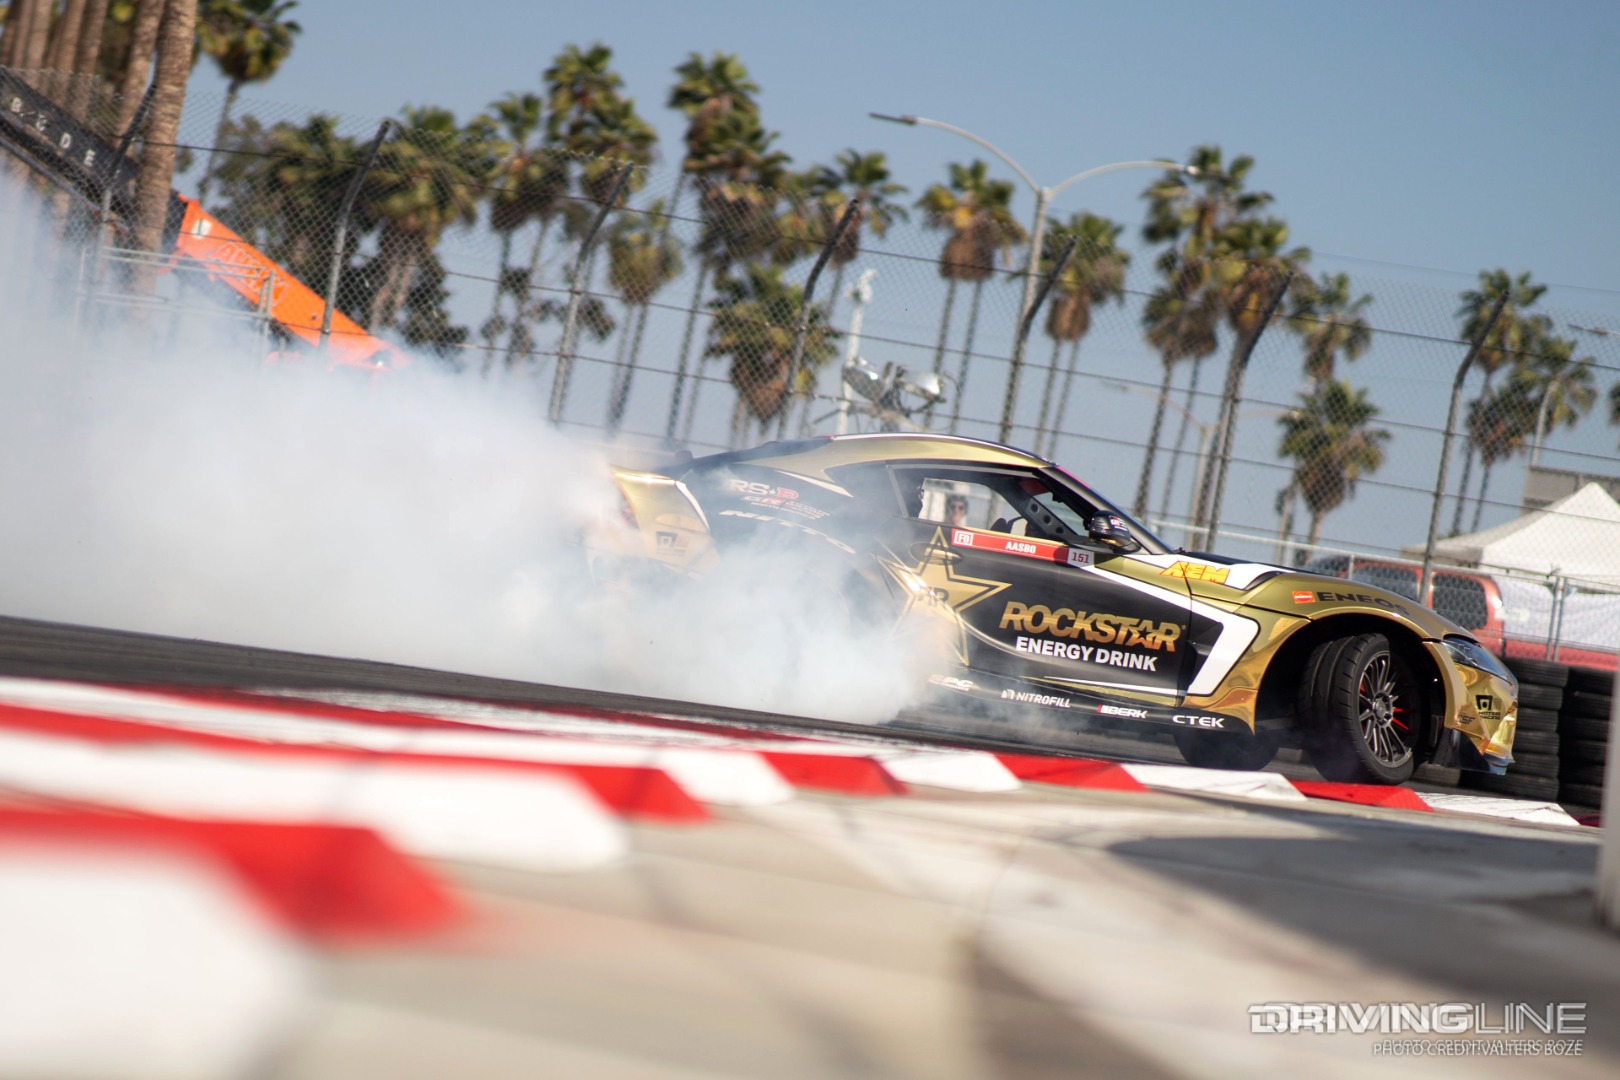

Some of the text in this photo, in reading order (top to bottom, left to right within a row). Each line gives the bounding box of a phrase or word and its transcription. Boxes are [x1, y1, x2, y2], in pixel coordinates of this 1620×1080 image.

[1005, 541, 1037, 554] AASBO
[1072, 551, 1090, 564] 151
[1159, 560, 1231, 585] AEM
[1316, 591, 1410, 616] ENEOS
[999, 601, 1181, 653] ROCKSTAR
[1016, 636, 1158, 672] ENERGY DRINK
[1016, 691, 1071, 709] NITROFILL
[1107, 705, 1147, 719] BERK
[1173, 714, 1225, 729] CTEK
